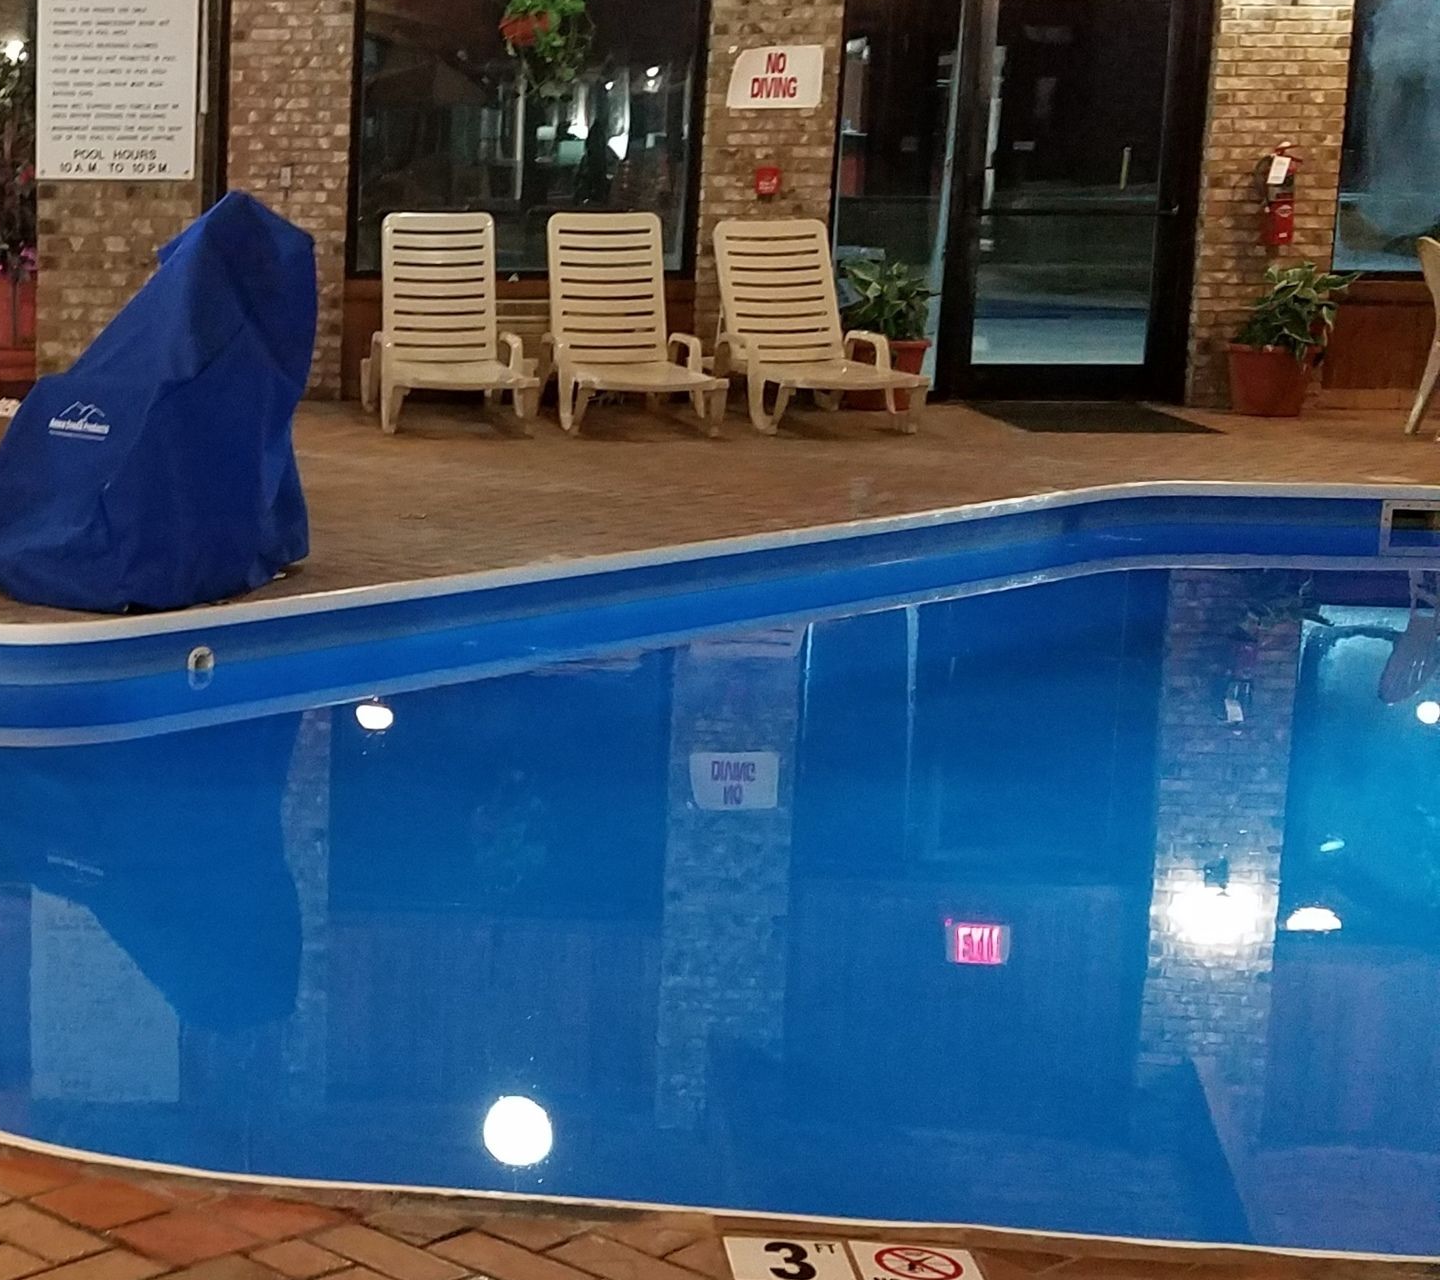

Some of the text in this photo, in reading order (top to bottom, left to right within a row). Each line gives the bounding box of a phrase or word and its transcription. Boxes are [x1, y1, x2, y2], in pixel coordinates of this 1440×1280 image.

[765, 52, 787, 74] NO
[750, 77, 798, 99] DIVING
[73, 148, 157, 161] POOL HOURS
[109, 162, 125, 173] TO
[814, 1243, 836, 1255] FT
